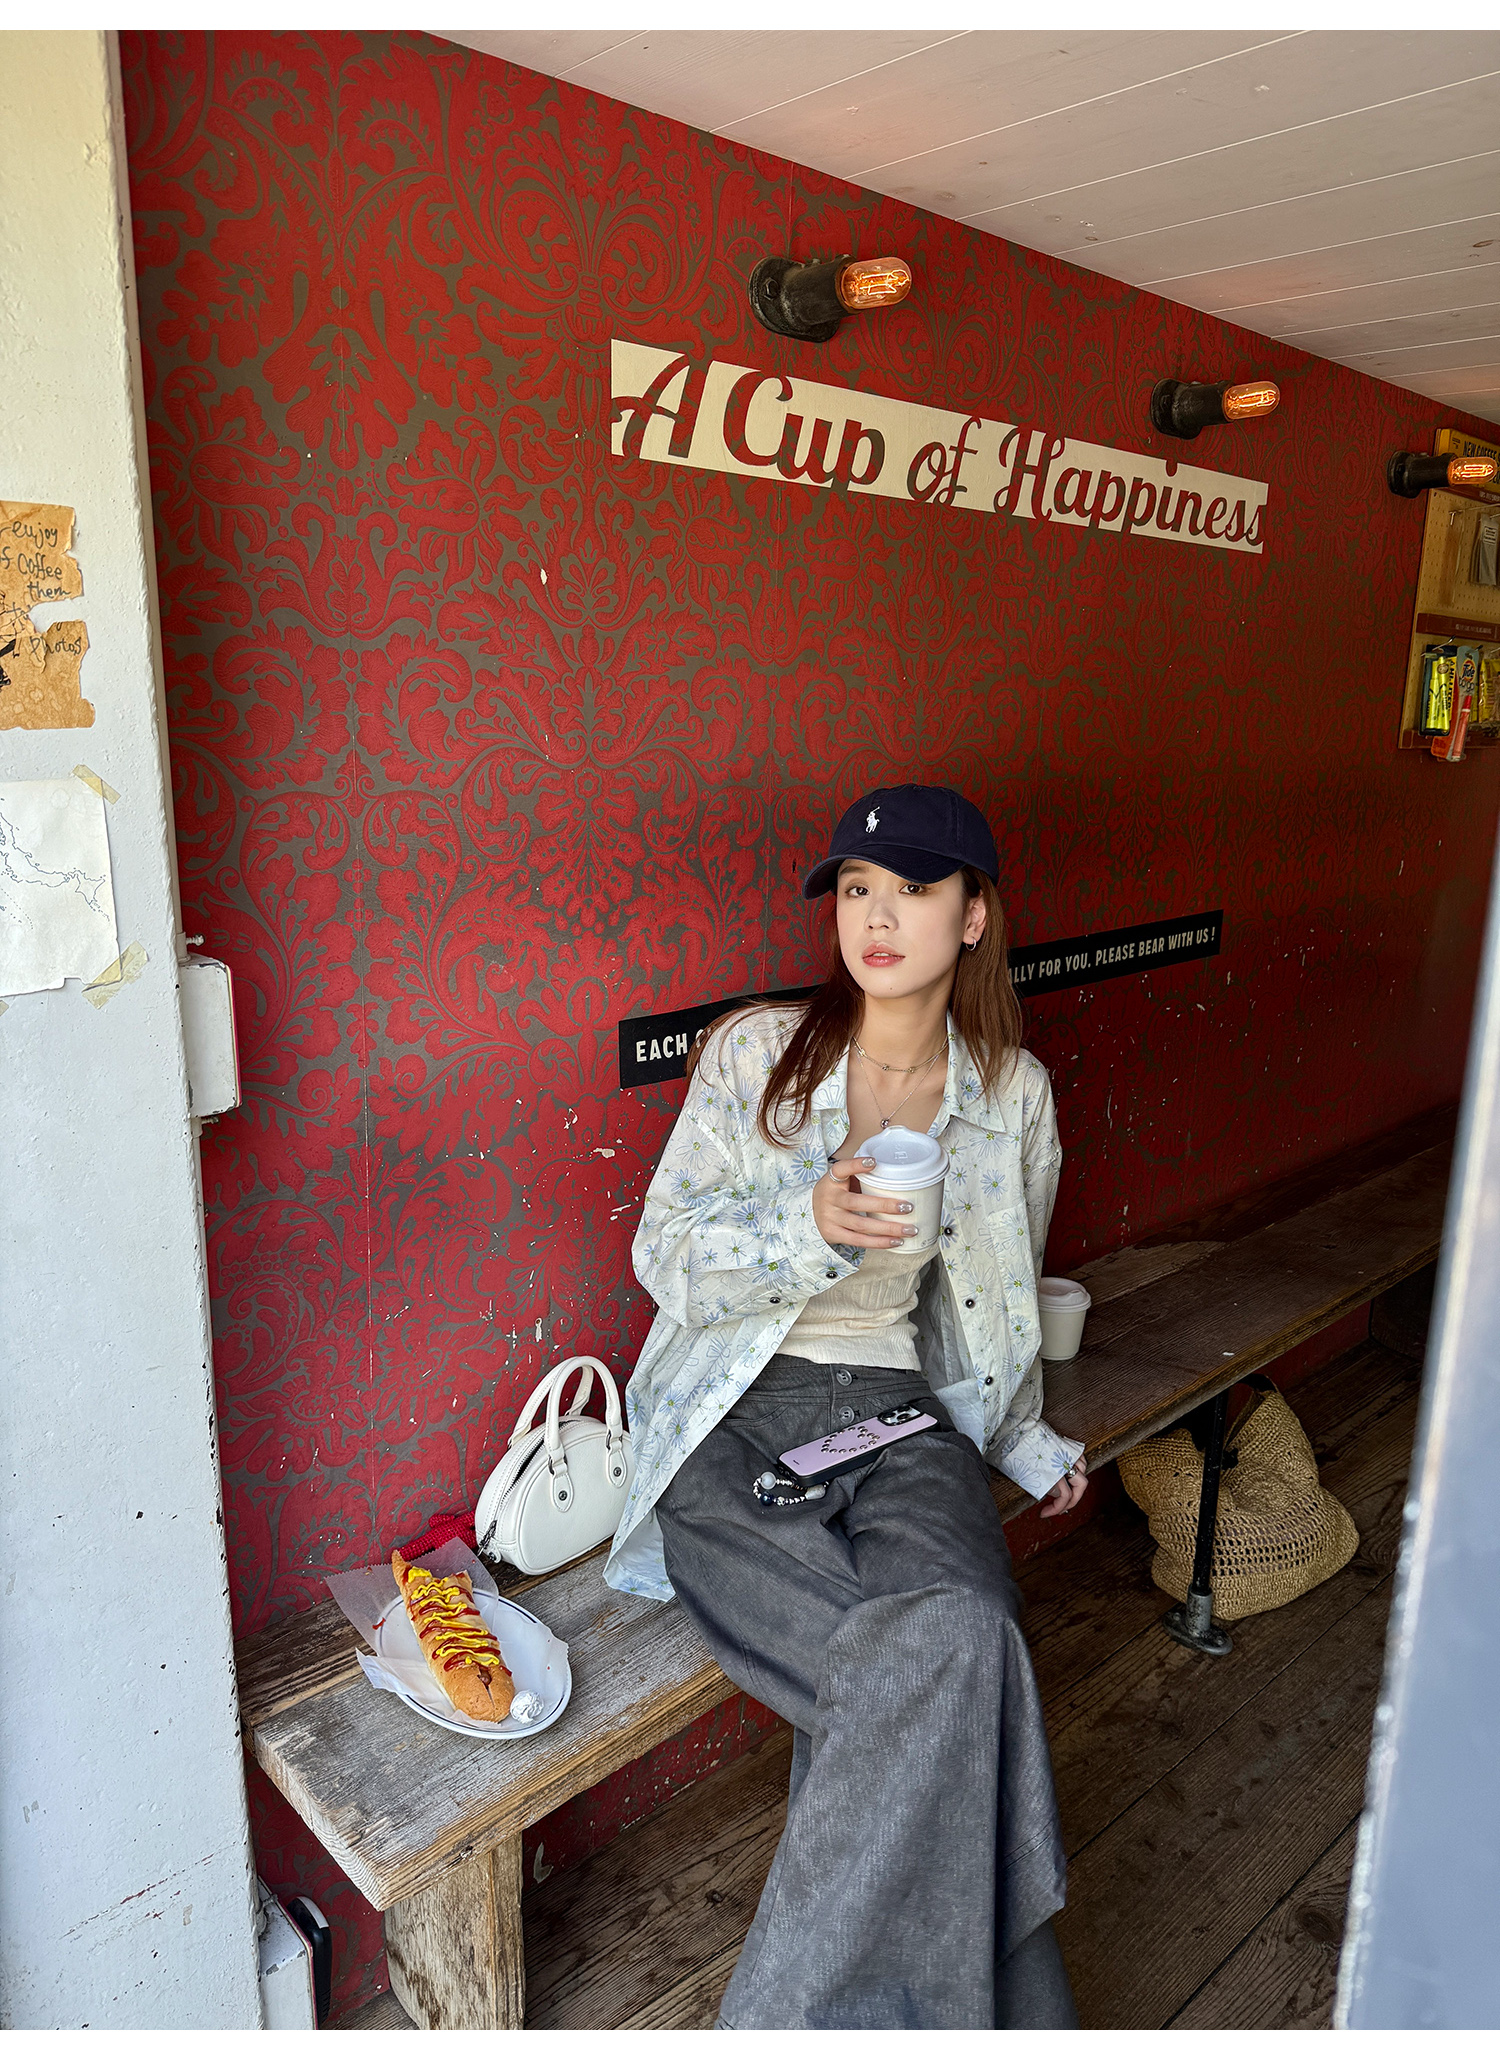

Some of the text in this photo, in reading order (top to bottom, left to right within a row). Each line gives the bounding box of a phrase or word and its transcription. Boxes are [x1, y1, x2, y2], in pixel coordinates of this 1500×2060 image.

[611, 354, 1265, 547] A Cup of Happiness
[17, 552, 62, 580] Coffee
[1461, 664, 1476, 679] Tide
[1039, 958, 1061, 978] FOR
[1065, 952, 1091, 972] YOU.
[1095, 943, 1135, 966] PLEASE
[1138, 937, 1165, 957] BEAR
[1168, 930, 1194, 950] WITH
[636, 1033, 688, 1062] EACH
